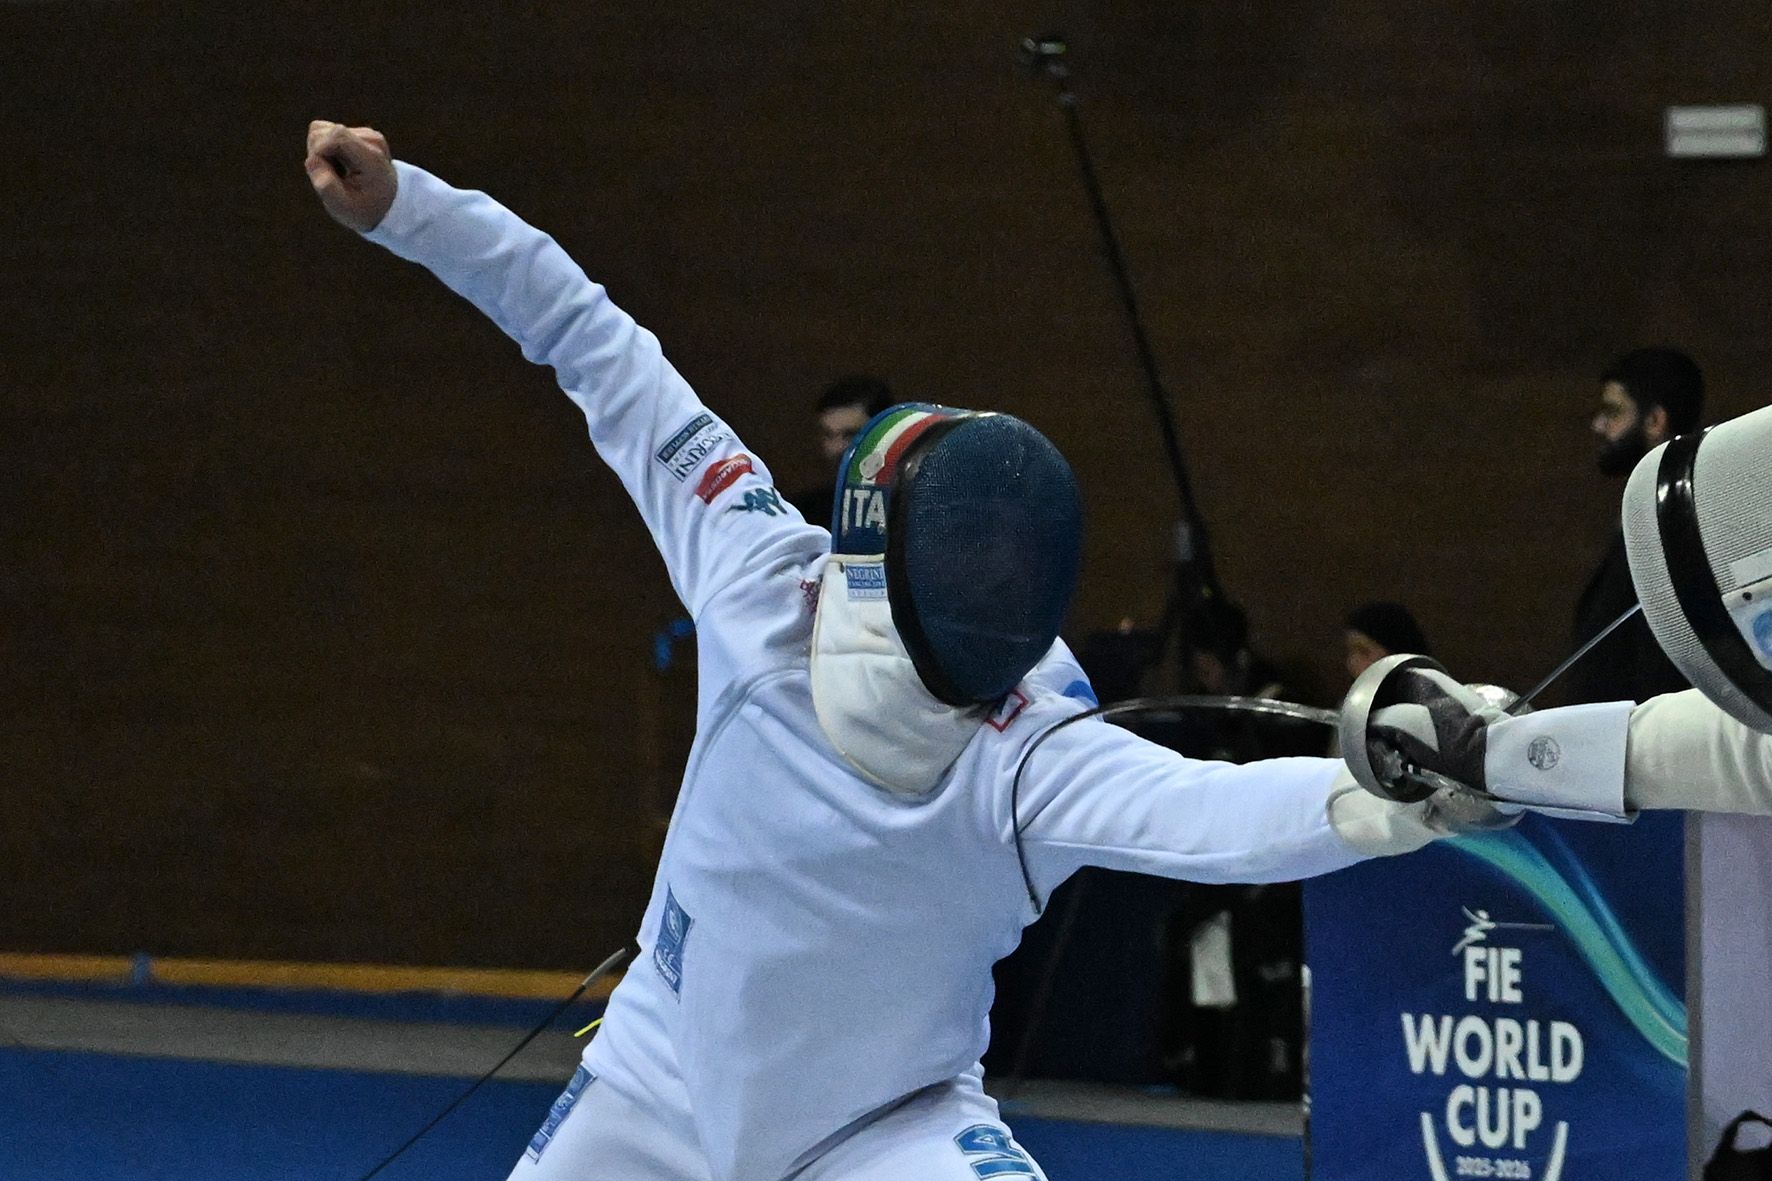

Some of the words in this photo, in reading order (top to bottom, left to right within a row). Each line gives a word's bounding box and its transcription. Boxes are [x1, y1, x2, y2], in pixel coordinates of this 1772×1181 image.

[841, 488, 887, 537] ITA
[1464, 945, 1523, 1004] FIE
[1400, 1011, 1585, 1084] WORLD
[1445, 1083, 1543, 1150] CUP
